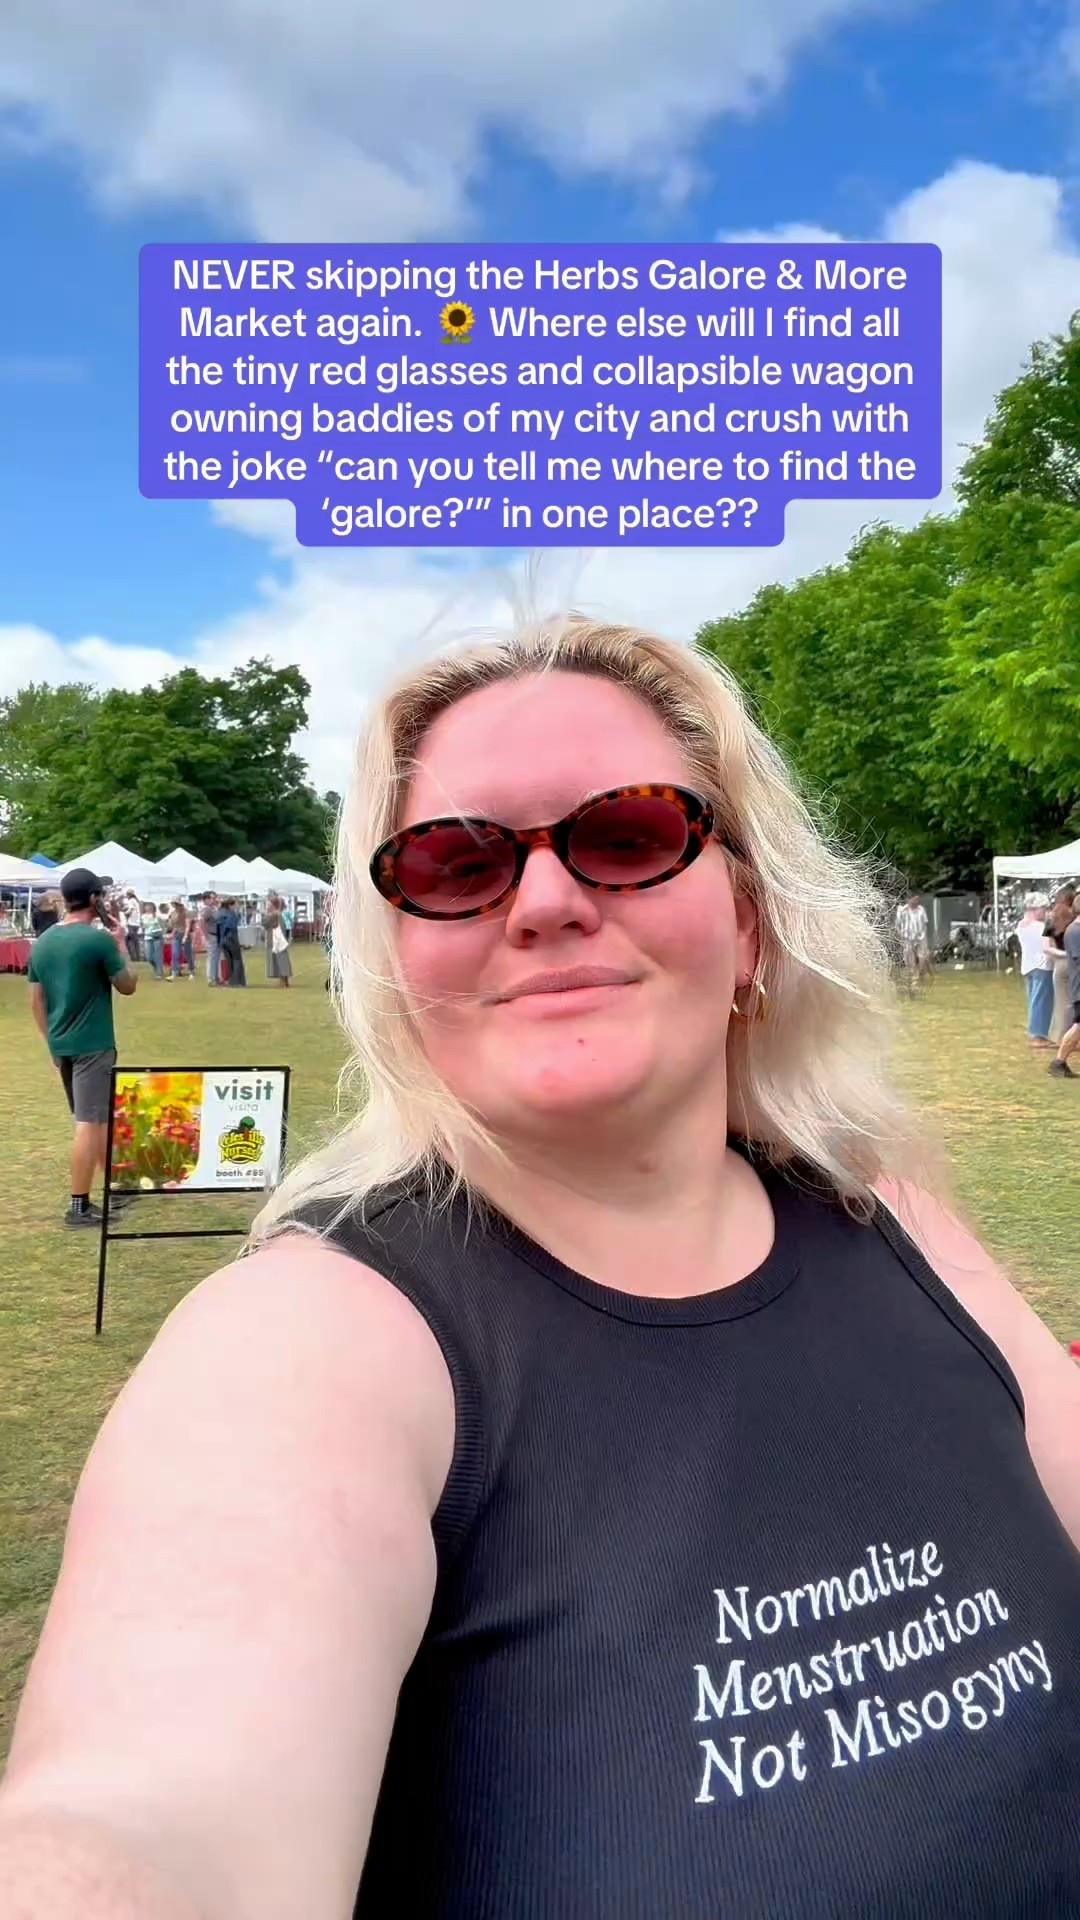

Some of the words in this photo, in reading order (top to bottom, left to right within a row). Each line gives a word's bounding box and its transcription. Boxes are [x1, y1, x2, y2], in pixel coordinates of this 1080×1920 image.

[215, 1079, 274, 1100] visit
[216, 1168, 243, 1177] booth
[713, 1541, 943, 1643] Normalize
[694, 1588, 1008, 1721] Menstruation
[695, 1730, 807, 1802] Not
[824, 1640, 1053, 1767] Misogyny
